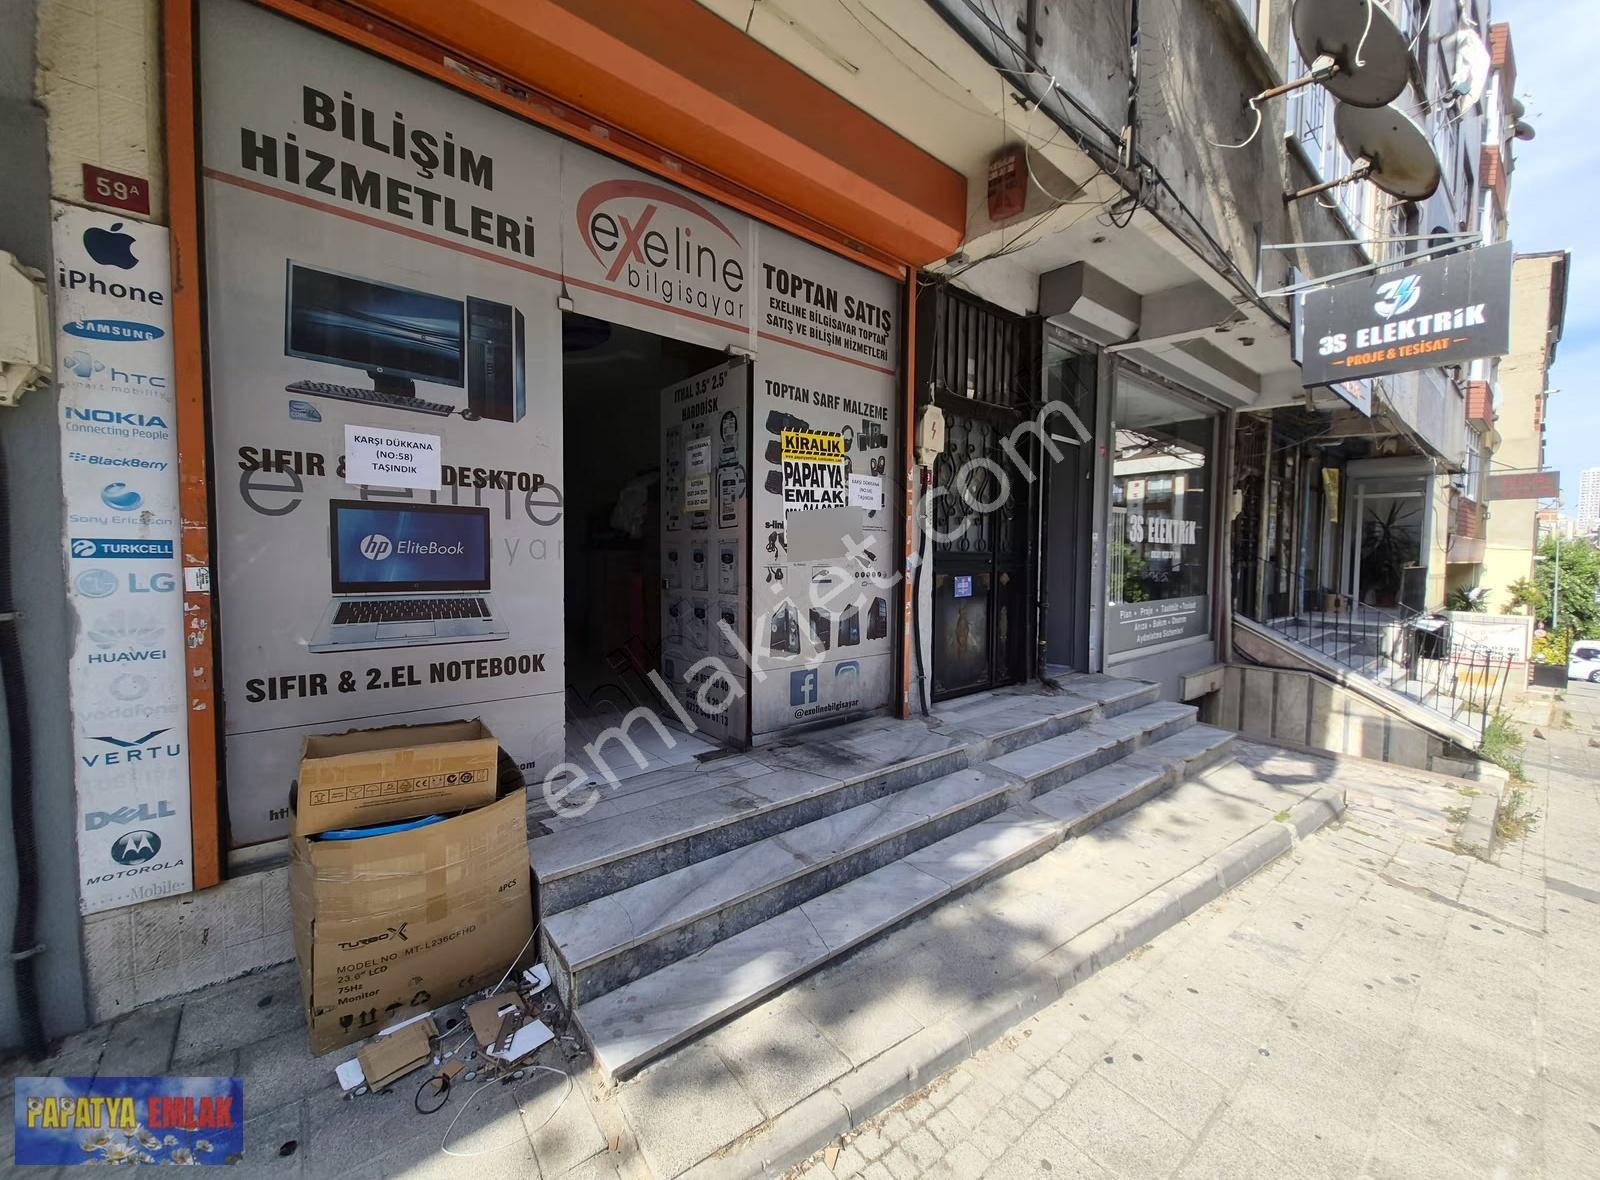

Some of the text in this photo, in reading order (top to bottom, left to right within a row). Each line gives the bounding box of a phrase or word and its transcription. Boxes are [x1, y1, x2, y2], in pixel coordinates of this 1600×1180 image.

[303, 85, 493, 190] BİLİŞİM
[240, 127, 536, 258] HİZMETLERİ
[59, 268, 164, 305] iPhone
[627, 262, 744, 320] bilgisayar
[763, 263, 892, 338] TOPTAN SATIŞ
[76, 320, 154, 340] SAMSUNG
[766, 313, 888, 361] SATIŞ VE BİLİŞİM HİZMETLERİ
[809, 310, 857, 336] BİLGİSAYAR
[859, 327, 886, 346] TOPTAN
[1319, 333, 1348, 356] 3S
[1346, 349, 1385, 367] PROJE
[1386, 348, 1397, 360] &
[765, 379, 888, 421] TOPTAN SARF MALZEME
[65, 406, 168, 429] NOKIA
[65, 422, 169, 441] Connecting People
[354, 435, 433, 451] KARŞI DÜKKANA
[785, 433, 840, 453] KİRALIK
[88, 455, 169, 471] BlackBerry
[376, 449, 413, 462] (NO:58)
[238, 446, 325, 477] SIFIR
[442, 464, 545, 493] DESKTOP
[371, 462, 417, 474] TAŞINDIK
[784, 461, 844, 489] PAPATYA
[785, 489, 844, 504] EMLAK
[69, 514, 108, 527] Sony
[1129, 514, 1144, 543] 3S
[100, 543, 172, 555] TURKCELL
[363, 534, 464, 561] hp EliteBook
[128, 572, 175, 593] LG
[88, 650, 166, 664] HUAWEI
[245, 653, 546, 703] SIFIR & 2.EL NOTEBOOK
[82, 744, 180, 767] VERTU
[85, 800, 176, 831] DELL
[86, 859, 184, 886] MOTOROLA
[498, 878, 517, 894] 4PCS
[336, 959, 379, 974] MODEL
[369, 965, 388, 976] LCD
[338, 983, 363, 995] 75Hz
[338, 989, 381, 1006] Monitor
